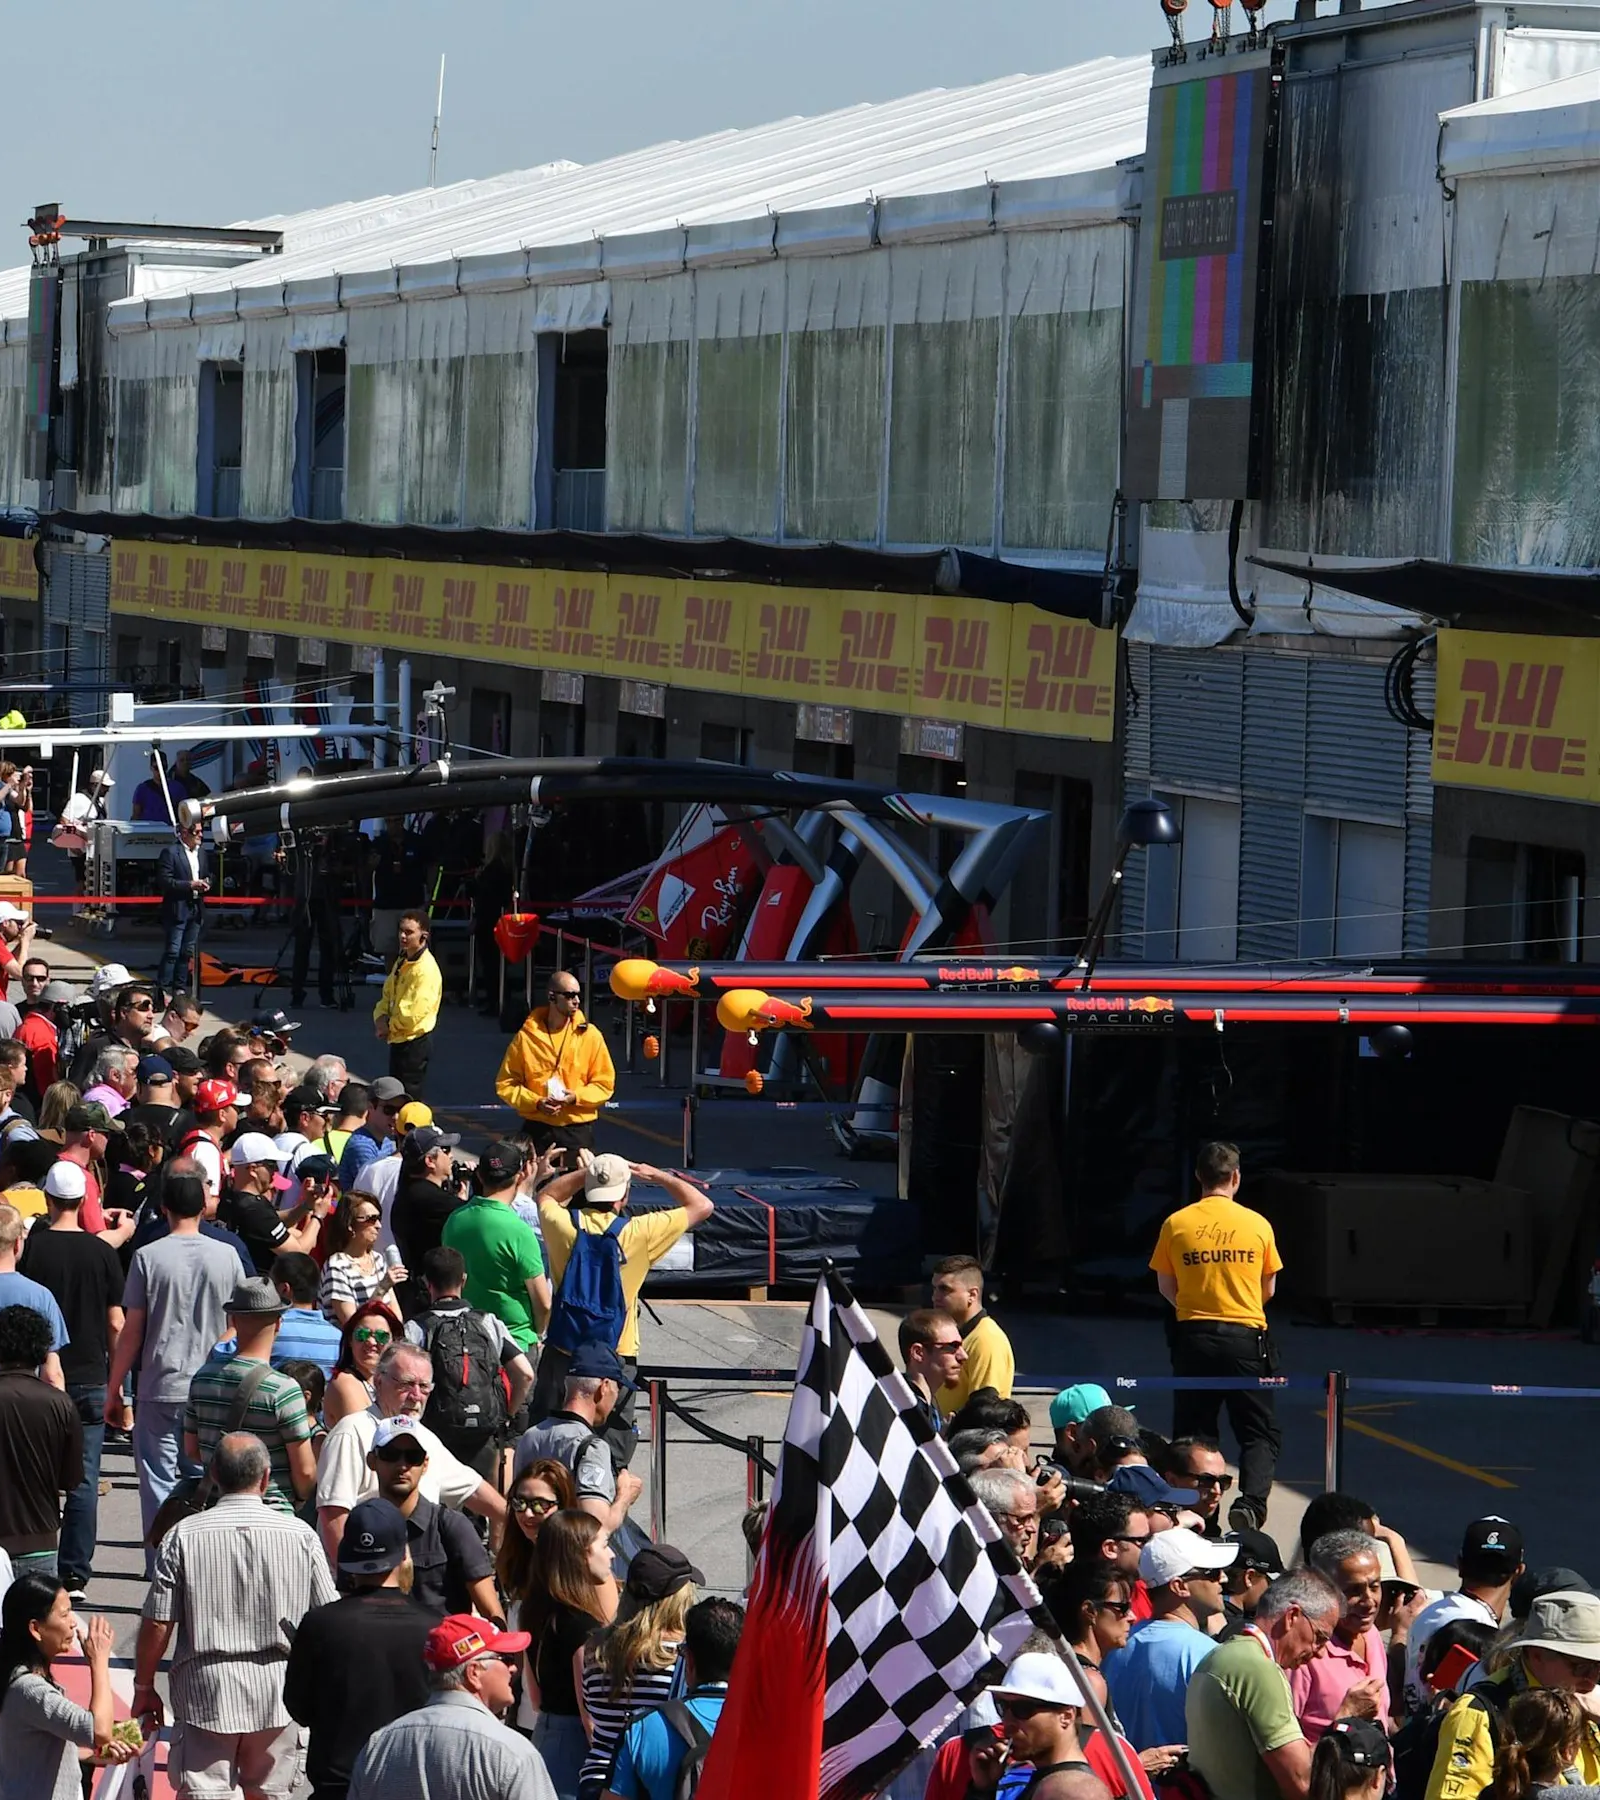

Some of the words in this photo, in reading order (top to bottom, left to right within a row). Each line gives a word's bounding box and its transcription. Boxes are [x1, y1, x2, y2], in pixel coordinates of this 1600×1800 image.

[493, 582, 532, 650] DHL
[553, 587, 596, 656] DHL
[614, 592, 661, 666] DHL
[681, 597, 732, 673] DHL
[757, 604, 812, 684] DHL
[836, 609, 897, 693] DHL
[922, 616, 990, 706] DHL
[1023, 623, 1098, 715] DHL
[1454, 658, 1565, 774] DHL
[938, 967, 966, 980] Red
[967, 968, 993, 980] Bull
[1066, 998, 1095, 1011] Red
[1096, 998, 1125, 1011] Bull
[1067, 1014, 1175, 1023] RACING
[1182, 1247, 1255, 1267] SÉCURITÉ
